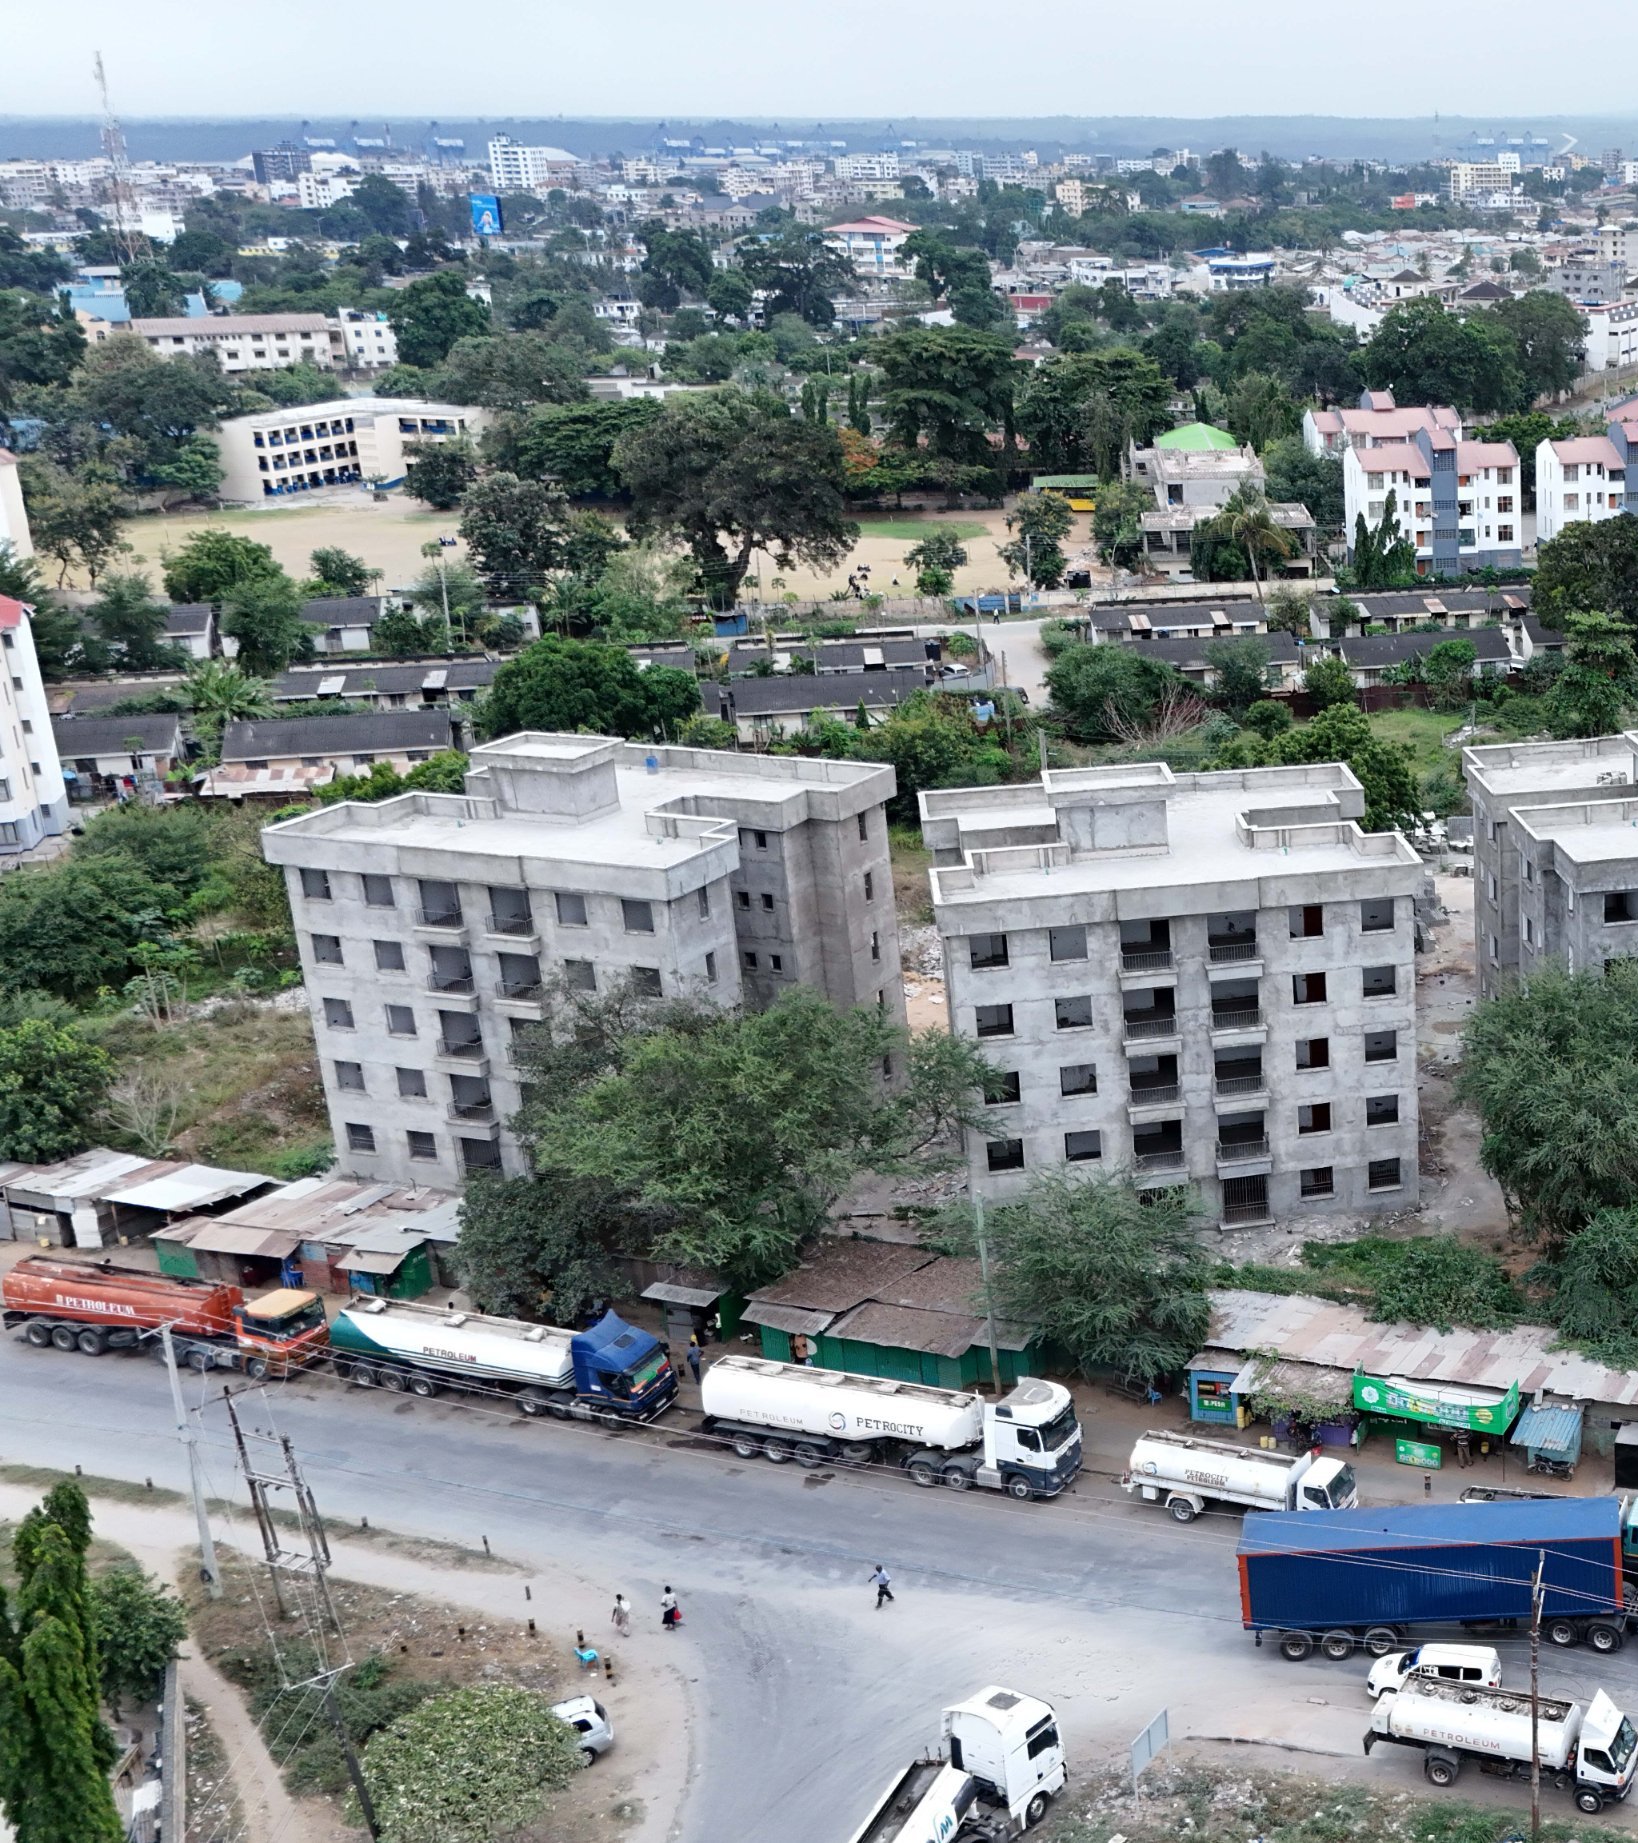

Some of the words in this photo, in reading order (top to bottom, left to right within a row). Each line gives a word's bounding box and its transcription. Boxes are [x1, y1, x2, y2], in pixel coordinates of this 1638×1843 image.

[65, 1296, 135, 1315] PETROLEUM
[423, 1346, 477, 1362] PETROLEUM
[740, 1408, 803, 1425] PETROLEUM
[856, 1417, 924, 1436] PETROCITY
[1184, 1469, 1230, 1482] PETROCITY
[1422, 1728, 1500, 1750] PETROLEUM
